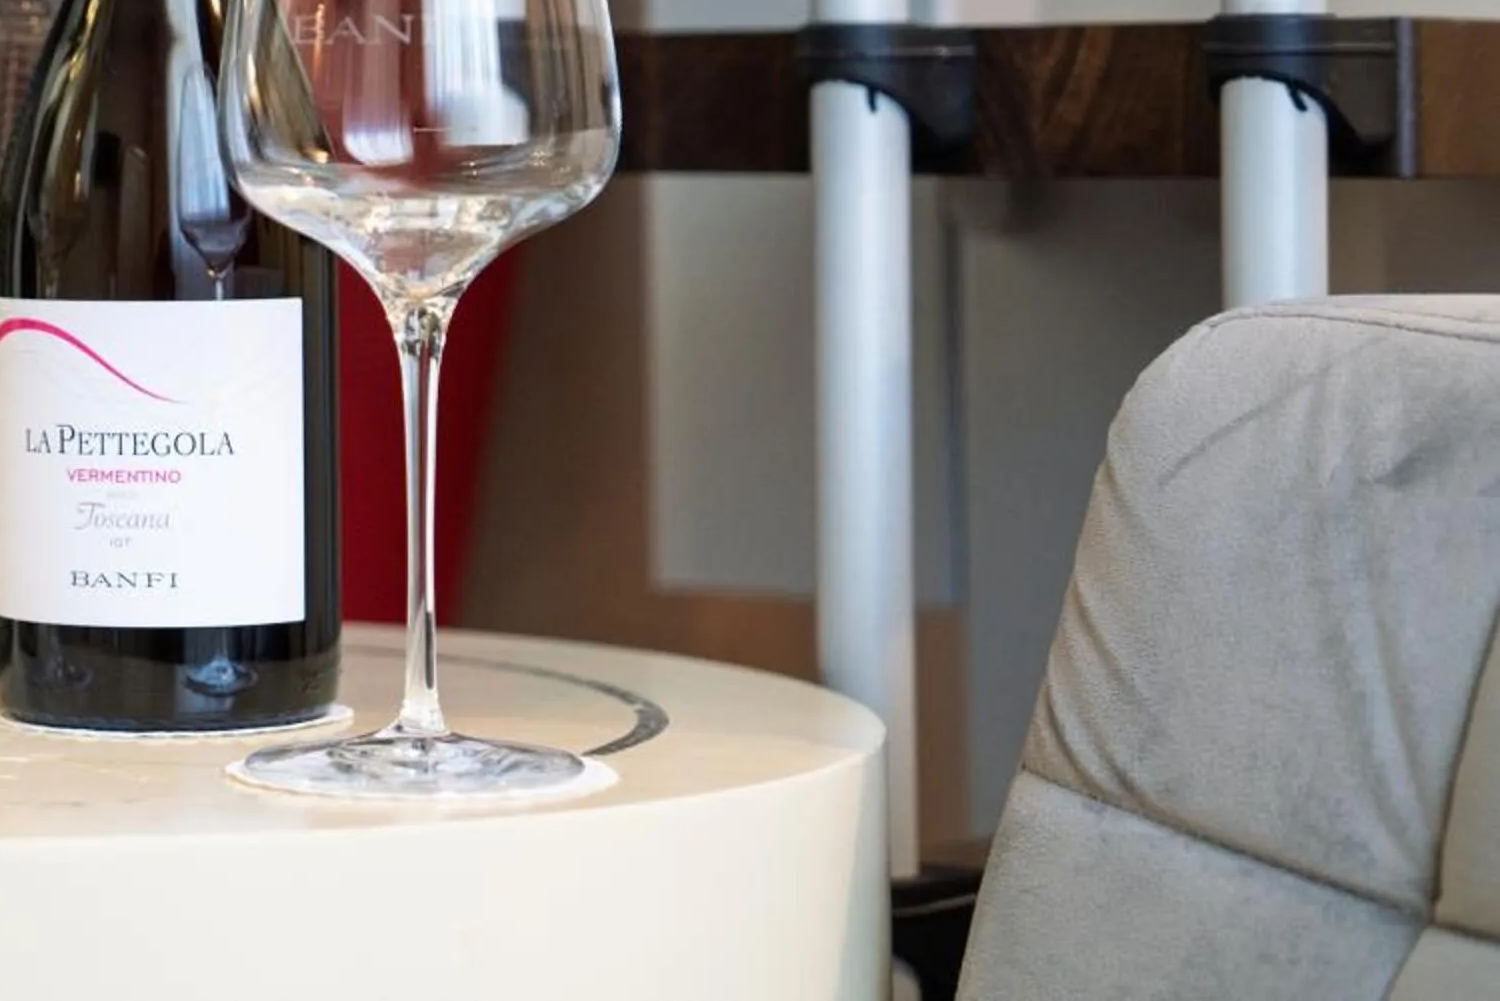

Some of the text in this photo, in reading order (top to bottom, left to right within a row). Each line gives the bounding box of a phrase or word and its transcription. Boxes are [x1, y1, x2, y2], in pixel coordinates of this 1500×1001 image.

[25, 424, 235, 456] LA PETTEGOLA
[67, 469, 182, 484] VERMENTINO
[74, 502, 171, 530] Toscana
[70, 571, 179, 588] BANFI
